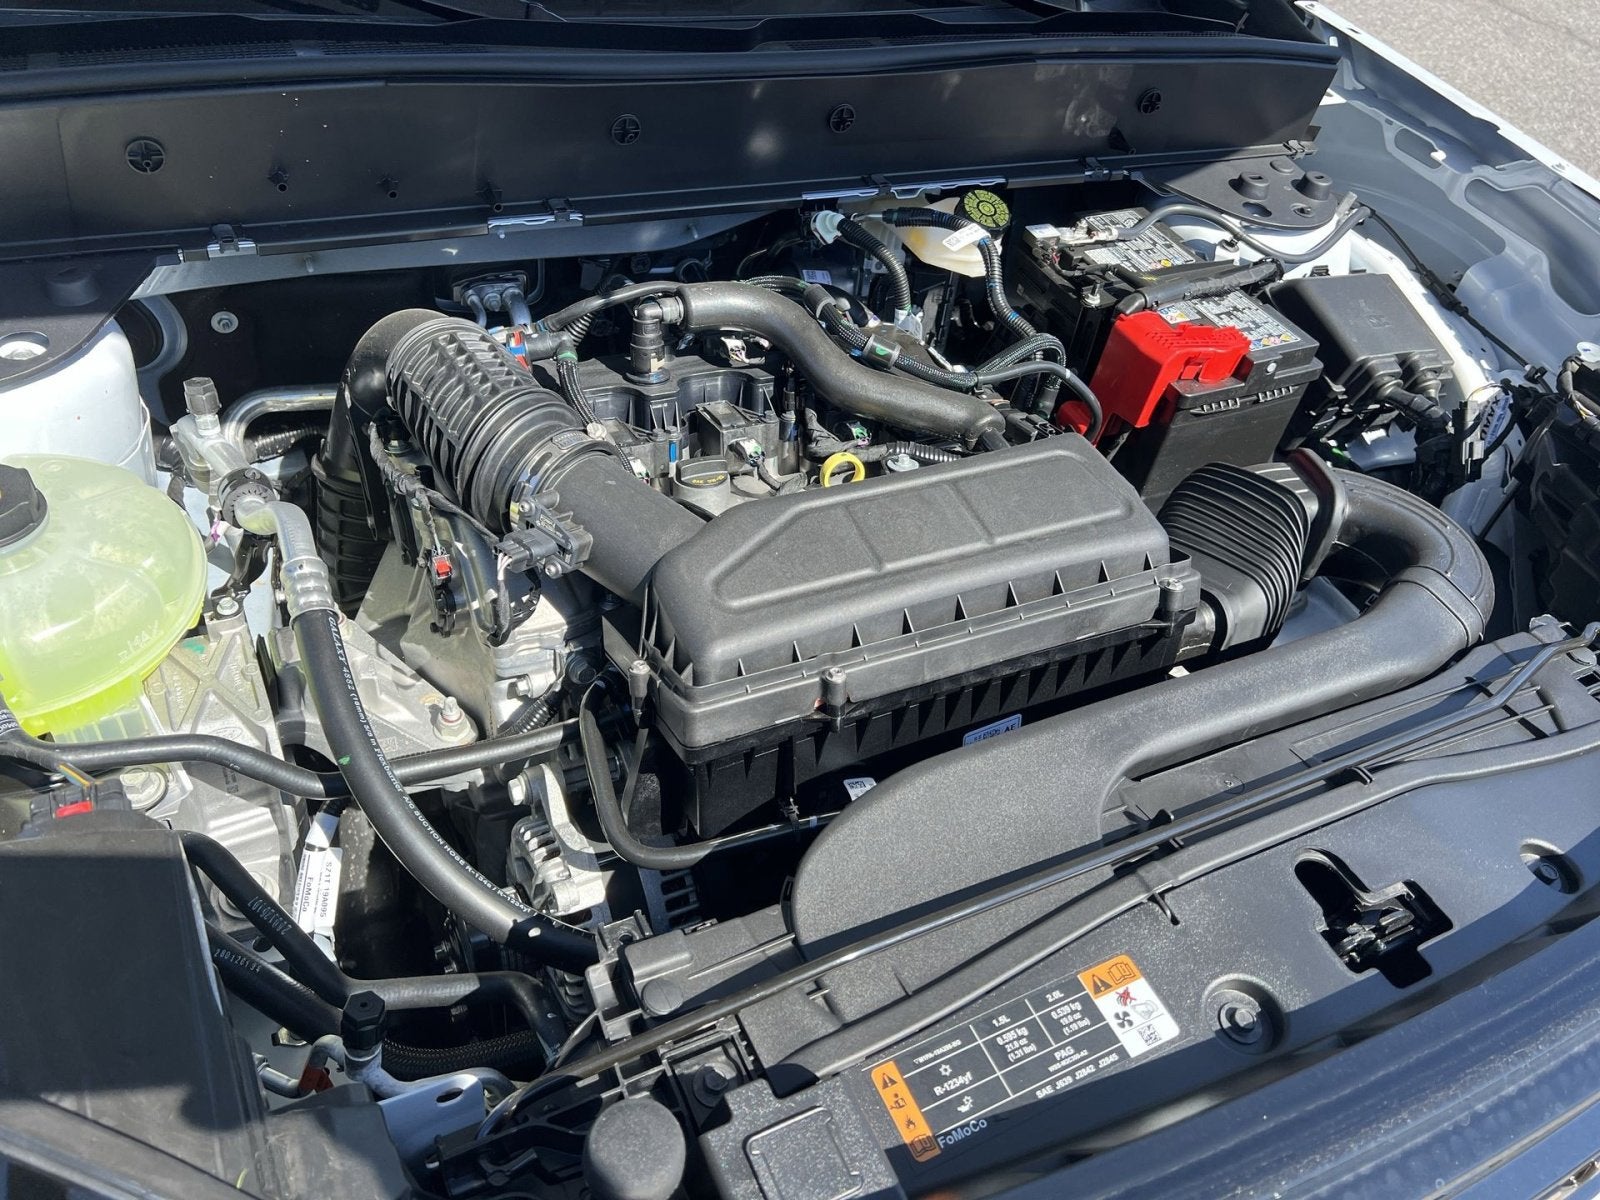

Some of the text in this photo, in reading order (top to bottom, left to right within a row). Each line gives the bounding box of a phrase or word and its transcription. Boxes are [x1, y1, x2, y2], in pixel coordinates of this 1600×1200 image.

[328, 616, 348, 666] GALAXY
[343, 666, 356, 691] 4882
[414, 810, 444, 845] SUCTION
[444, 845, 466, 866] HOSE
[302, 876, 314, 912] FoMoCo
[1045, 990, 1064, 1003] 2.0L
[1069, 1001, 1082, 1012] kg
[992, 1014, 1011, 1028] 1.5L
[1077, 1017, 1091, 1030] lbs)
[996, 1026, 1029, 1046] 0.595 kg
[1023, 1042, 1037, 1056] lbs)
[1054, 1045, 1075, 1061] PAG
[933, 1071, 973, 1096] R-1234yf
[1035, 1084, 1055, 1099] SAE
[1055, 1075, 1074, 1090] J639
[937, 1119, 987, 1149] FoMoCo
